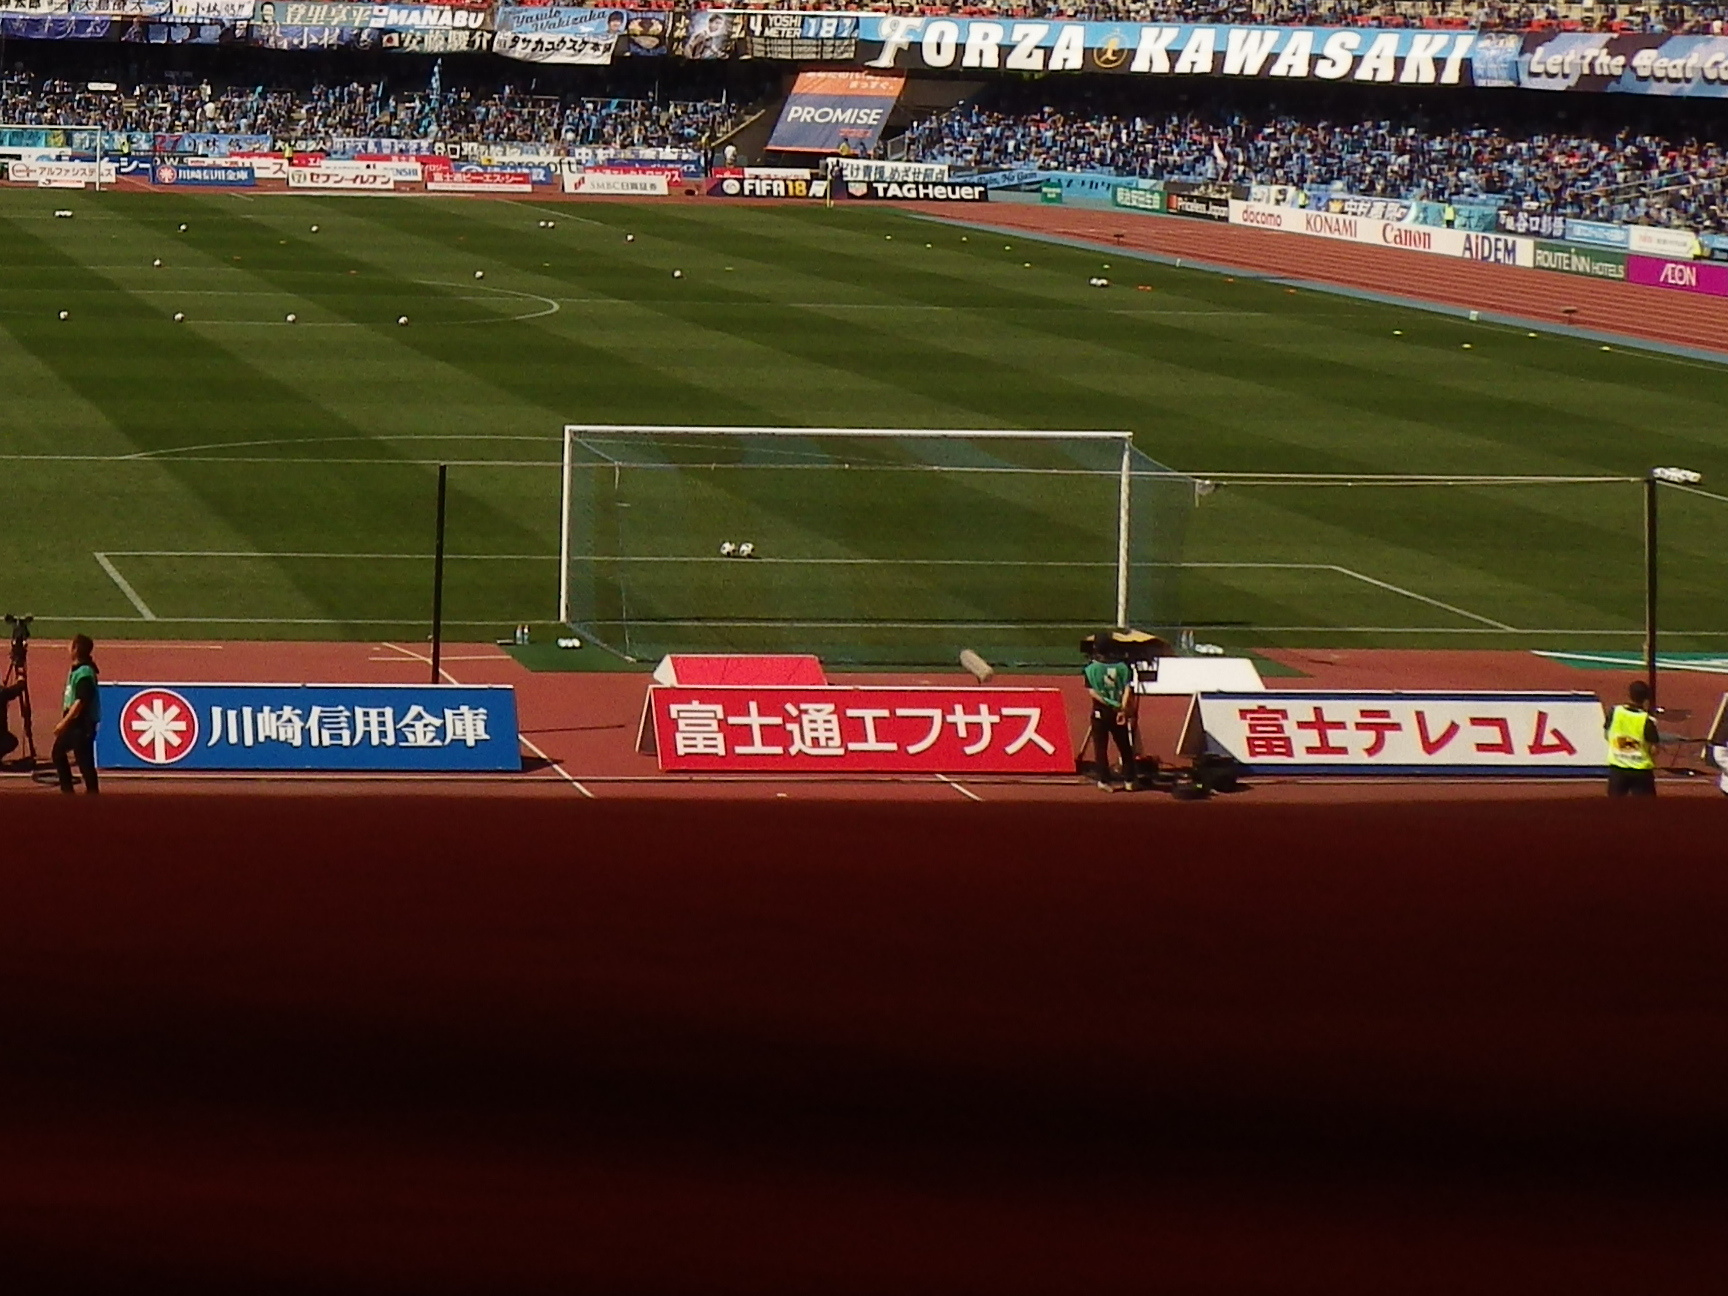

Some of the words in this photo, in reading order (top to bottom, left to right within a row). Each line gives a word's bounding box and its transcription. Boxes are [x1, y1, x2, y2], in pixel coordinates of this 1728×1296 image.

[386, 8, 485, 29] MANABU
[513, 8, 562, 27] Yasuto
[531, 10, 607, 31] Wakizaka
[769, 15, 802, 27] YOSHI
[763, 27, 802, 37] METER
[863, 17, 1085, 71] FORZA
[1129, 27, 1474, 85] KAWASAKI
[1529, 46, 1577, 77] Let
[1581, 47, 1627, 77] The
[1632, 48, 1700, 82] Beat
[786, 106, 883, 125] PROMISE
[743, 179, 785, 196] FIFA
[787, 180, 807, 197] 18
[1242, 208, 1282, 226] docomo
[1305, 213, 1357, 238] KONAMI
[1382, 222, 1431, 249] Canon
[1536, 249, 1570, 270] ROUTE
[1592, 261, 1624, 278] HOTELS
[206, 704, 491, 748] 川崎信用金庫
[668, 701, 1056, 757] 富士通エフサス
[1238, 705, 1577, 759] 富士テレコム
